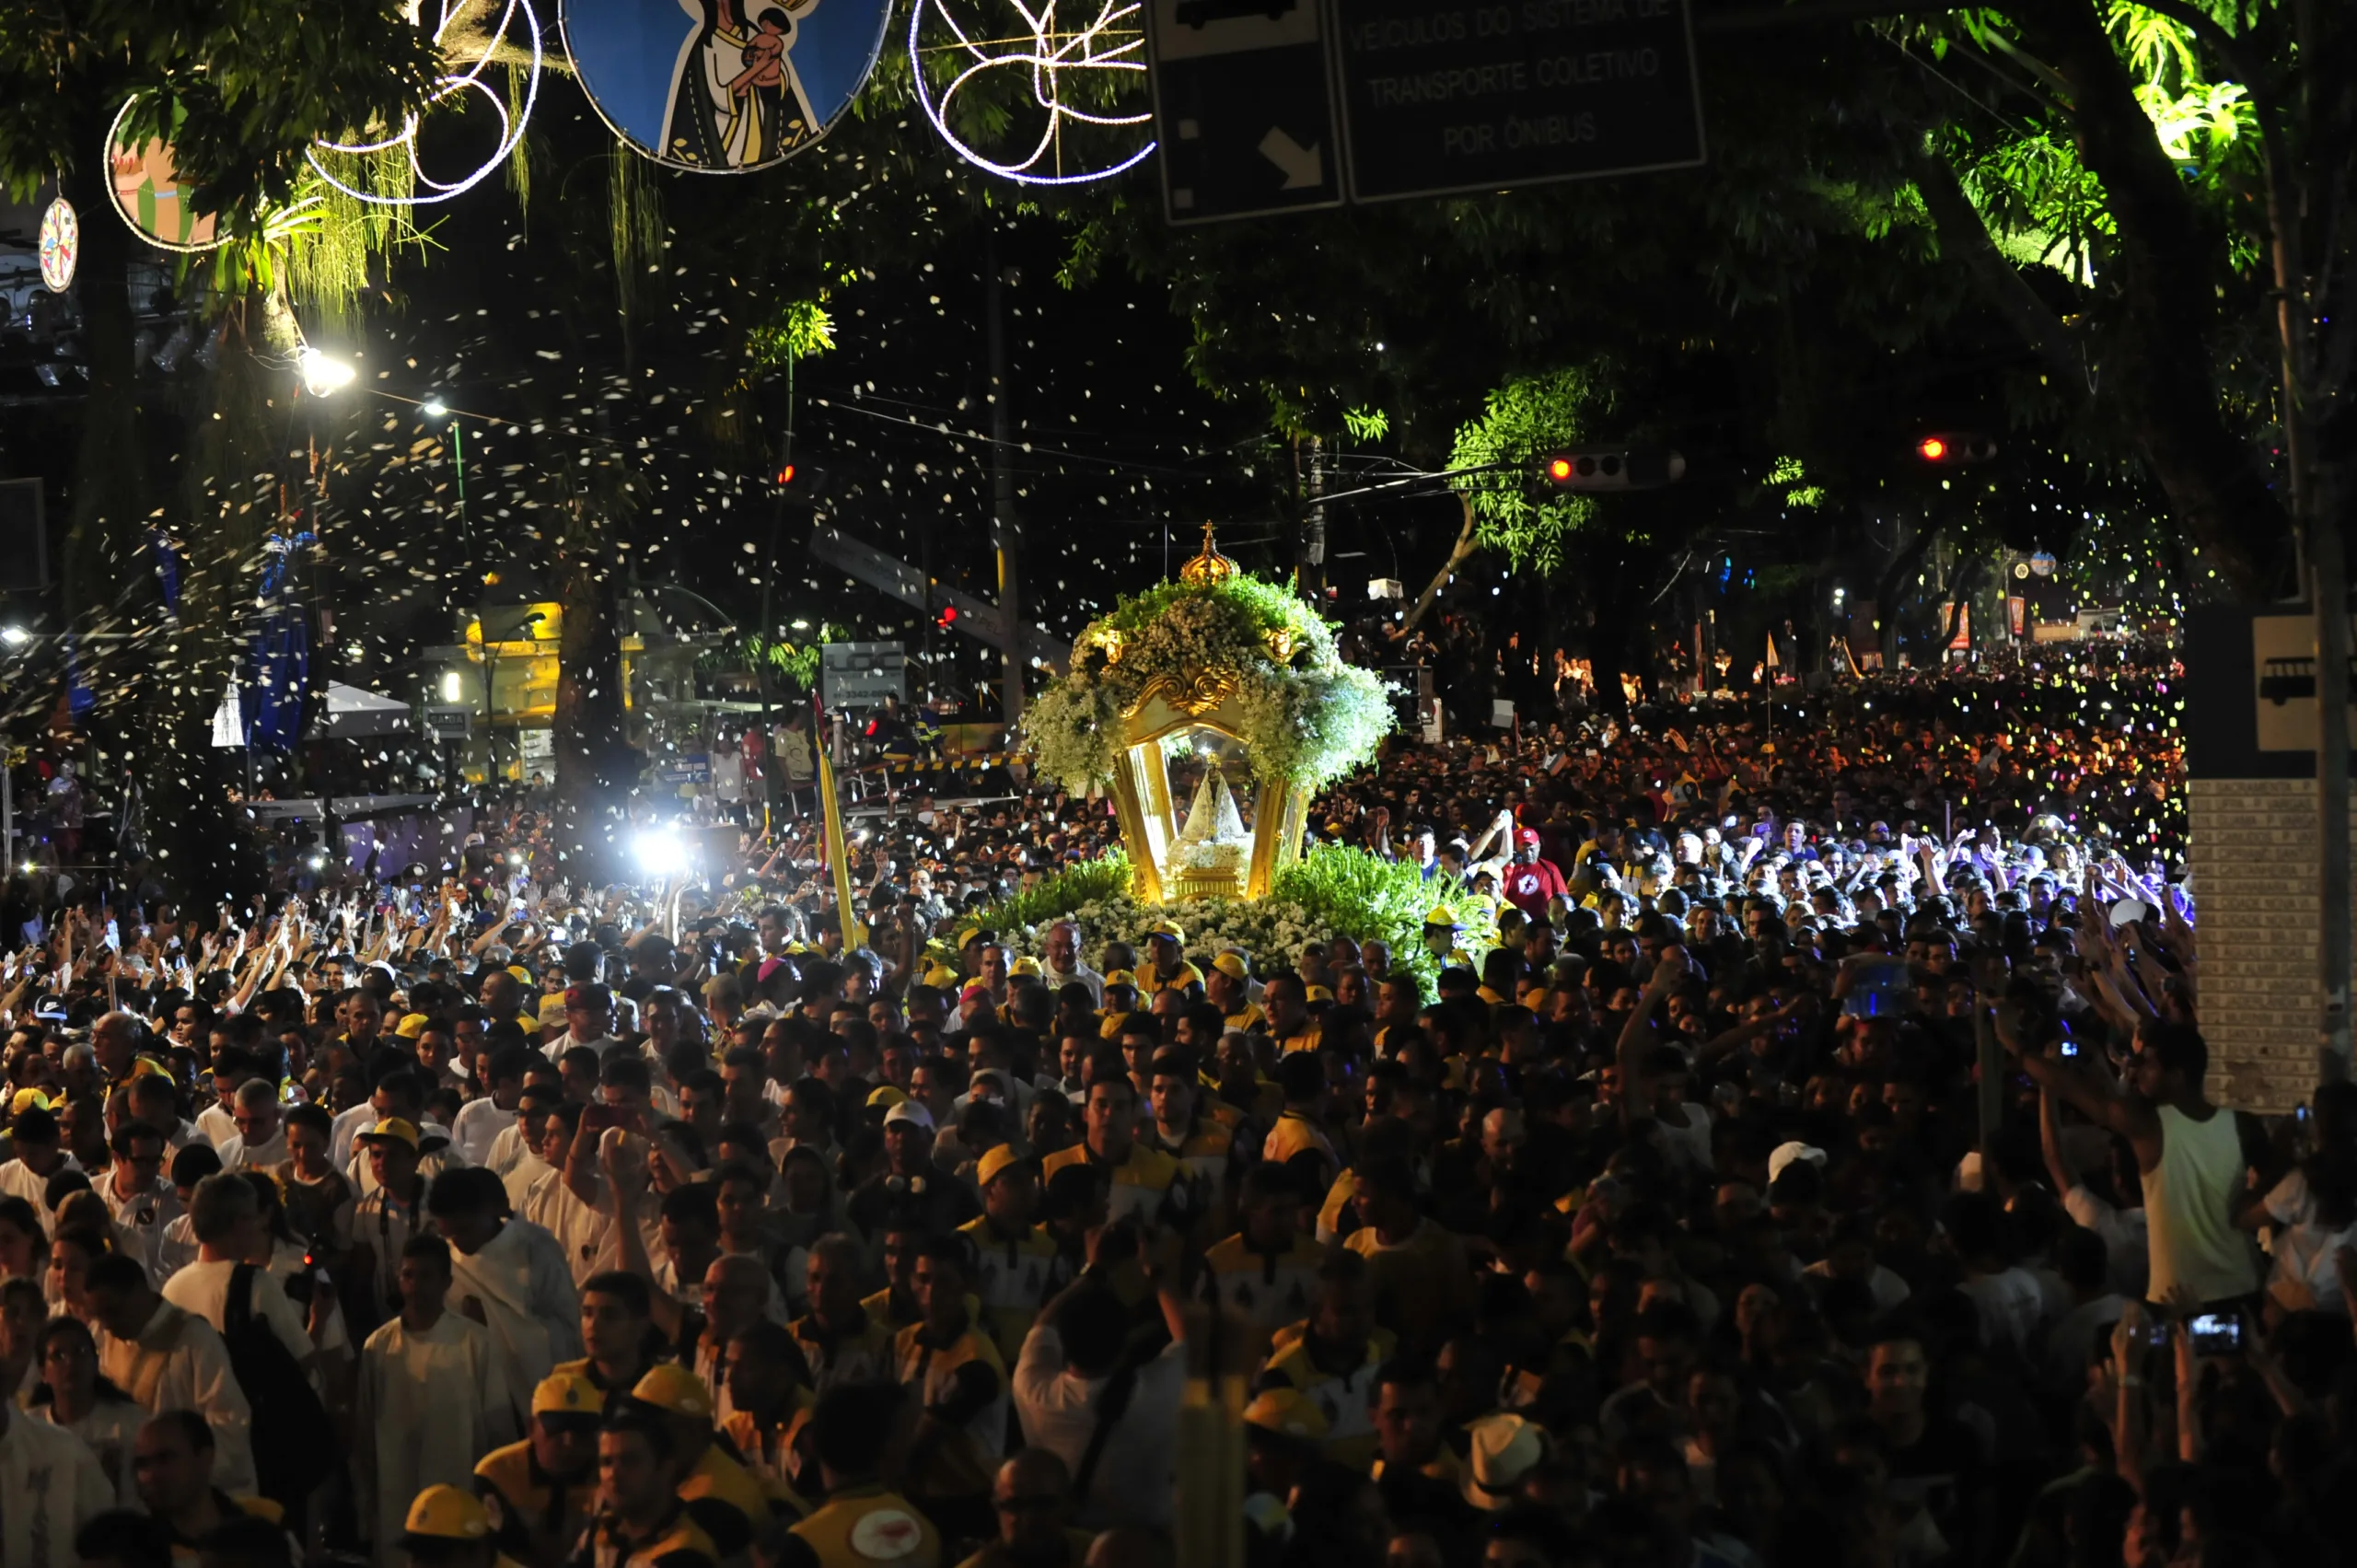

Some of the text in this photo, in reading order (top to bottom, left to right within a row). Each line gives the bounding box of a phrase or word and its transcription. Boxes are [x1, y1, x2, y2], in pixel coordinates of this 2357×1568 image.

[1349, 11, 1466, 51] VEÍCULOS
[1475, 6, 1511, 38] DO
[1521, 0, 1627, 32] SISTEMA
[1366, 47, 1659, 109] TRANSPORTE COLETIVO
[1443, 111, 1596, 156] POR ÔNIBUS
[825, 651, 901, 671] LOC
